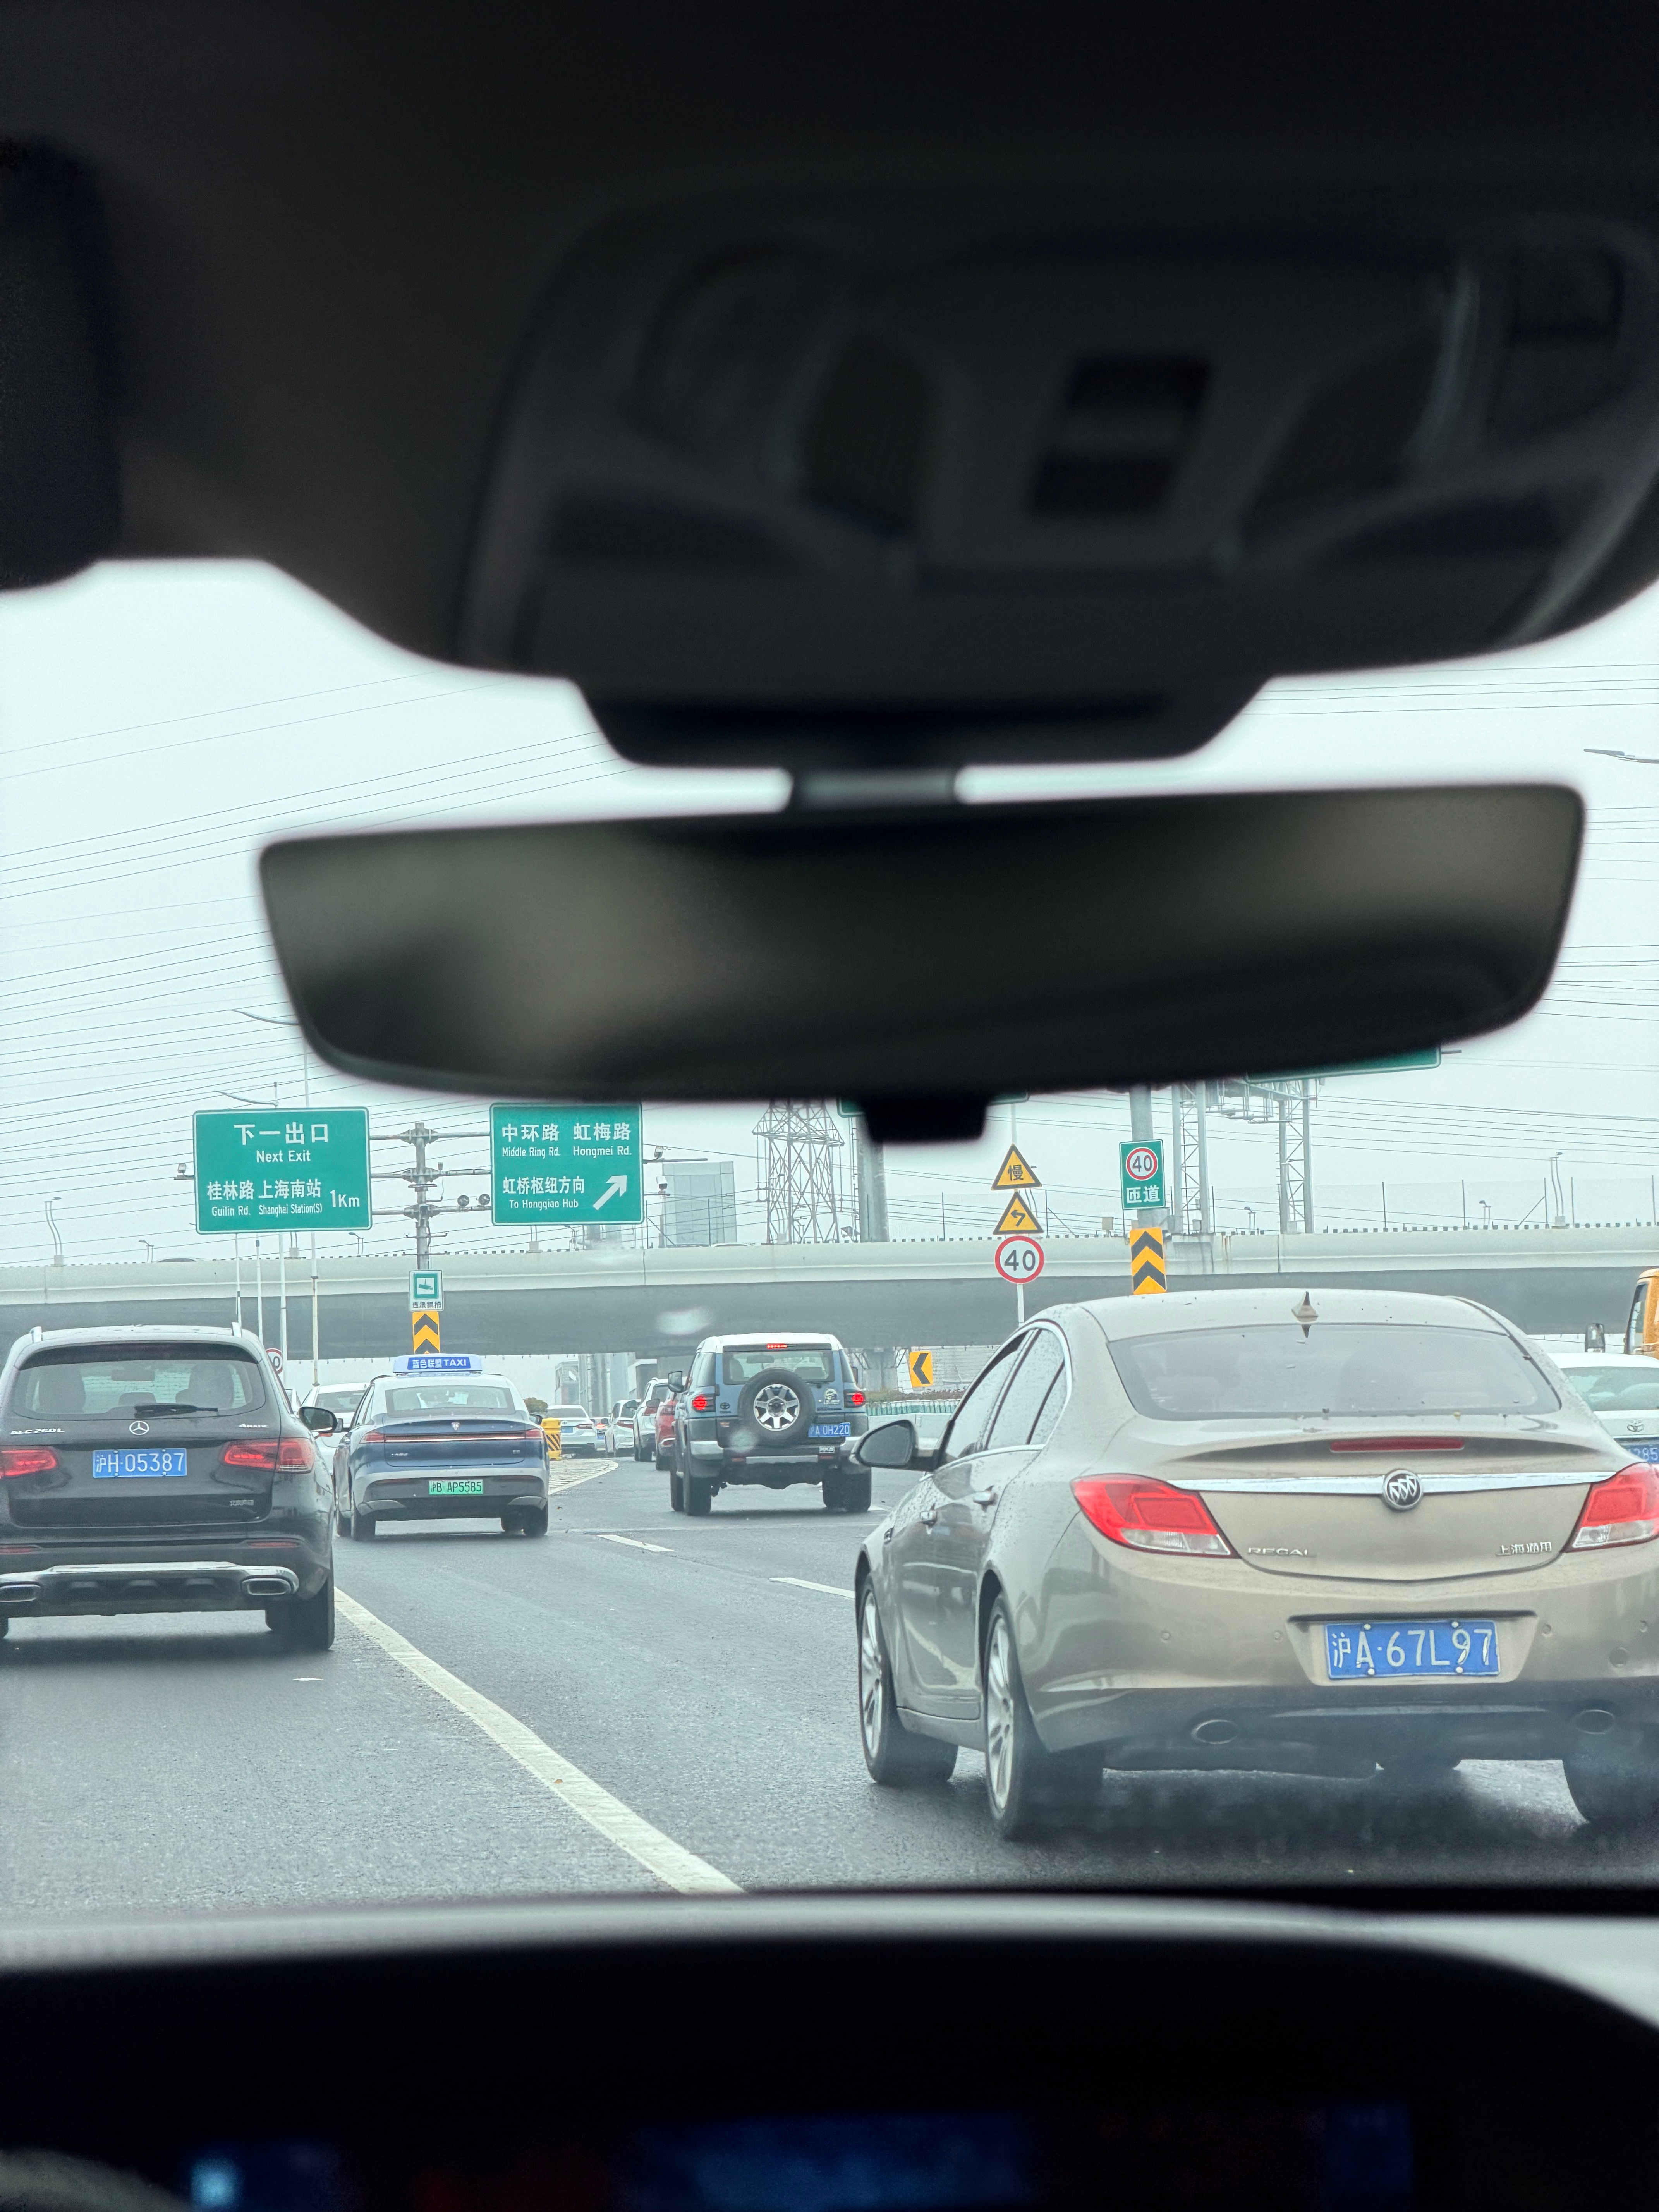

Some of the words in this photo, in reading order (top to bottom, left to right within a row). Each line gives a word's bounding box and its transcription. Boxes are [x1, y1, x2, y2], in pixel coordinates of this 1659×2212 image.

[234, 1122, 328, 1145] 下一出口
[502, 1123, 560, 1142] 中环路
[573, 1122, 631, 1141] 虹梅路
[256, 1150, 283, 1163] Next
[288, 1150, 311, 1162] Exit
[502, 1147, 526, 1157] Middle
[529, 1147, 545, 1159] Ring
[549, 1147, 560, 1156] Rd.
[573, 1146, 613, 1158] Hongmei
[617, 1146, 632, 1156] Rd.
[1132, 1155, 1152, 1172] 40
[1007, 1164, 1024, 1181] 慢
[207, 1180, 254, 1200] 桂林路
[258, 1178, 321, 1199] 上海南站
[503, 1176, 585, 1195] 虹桥枢纽方向
[1127, 1185, 1160, 1204] 匝道
[212, 1206, 235, 1216] Guilin
[238, 1206, 251, 1216] Rd.
[259, 1204, 288, 1218] Shanghai
[291, 1203, 322, 1214] Station(S)
[509, 1200, 519, 1209] To
[522, 1200, 559, 1211] Hongqiao
[563, 1199, 579, 1208] Hub
[1004, 1250, 1036, 1271] 40
